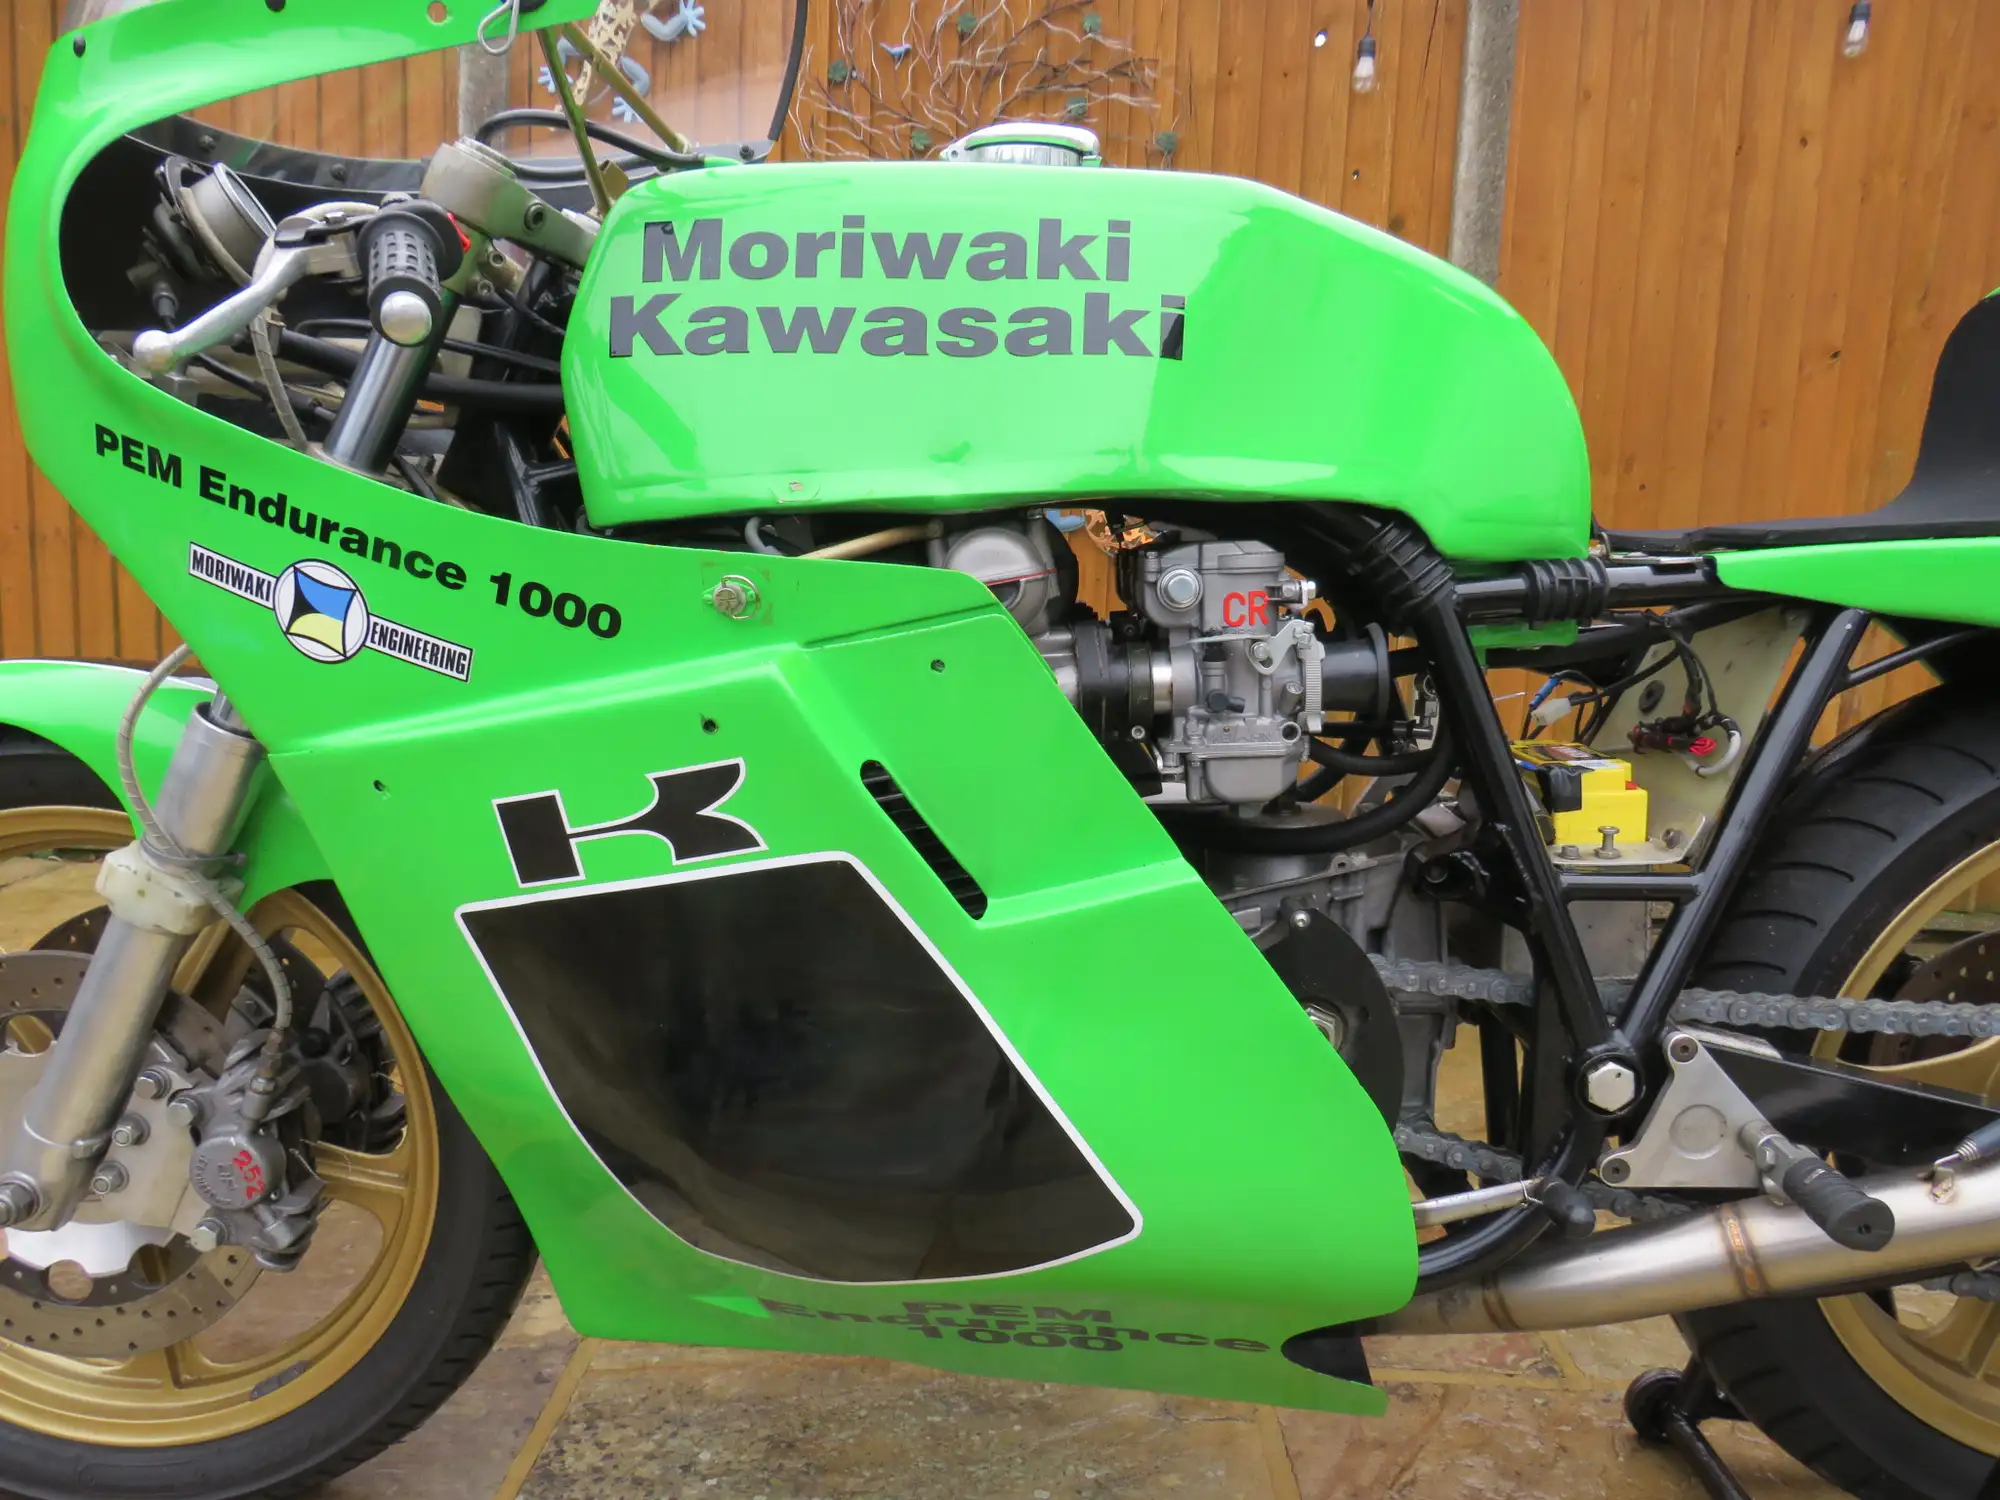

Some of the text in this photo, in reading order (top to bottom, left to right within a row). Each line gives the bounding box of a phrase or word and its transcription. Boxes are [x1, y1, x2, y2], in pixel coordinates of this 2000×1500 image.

[641, 215, 1130, 282] Moriwaki
[609, 292, 1186, 360] Kawasaki
[95, 423, 622, 640] PEM Endurance 1000
[191, 549, 272, 602] MORIWAKI
[1223, 590, 1270, 627] CR
[370, 621, 468, 675] ENGINEERING
[758, 1298, 1271, 1352] Endurance
[902, 1302, 1112, 1323] PEM
[907, 1325, 1124, 1352] 1000
